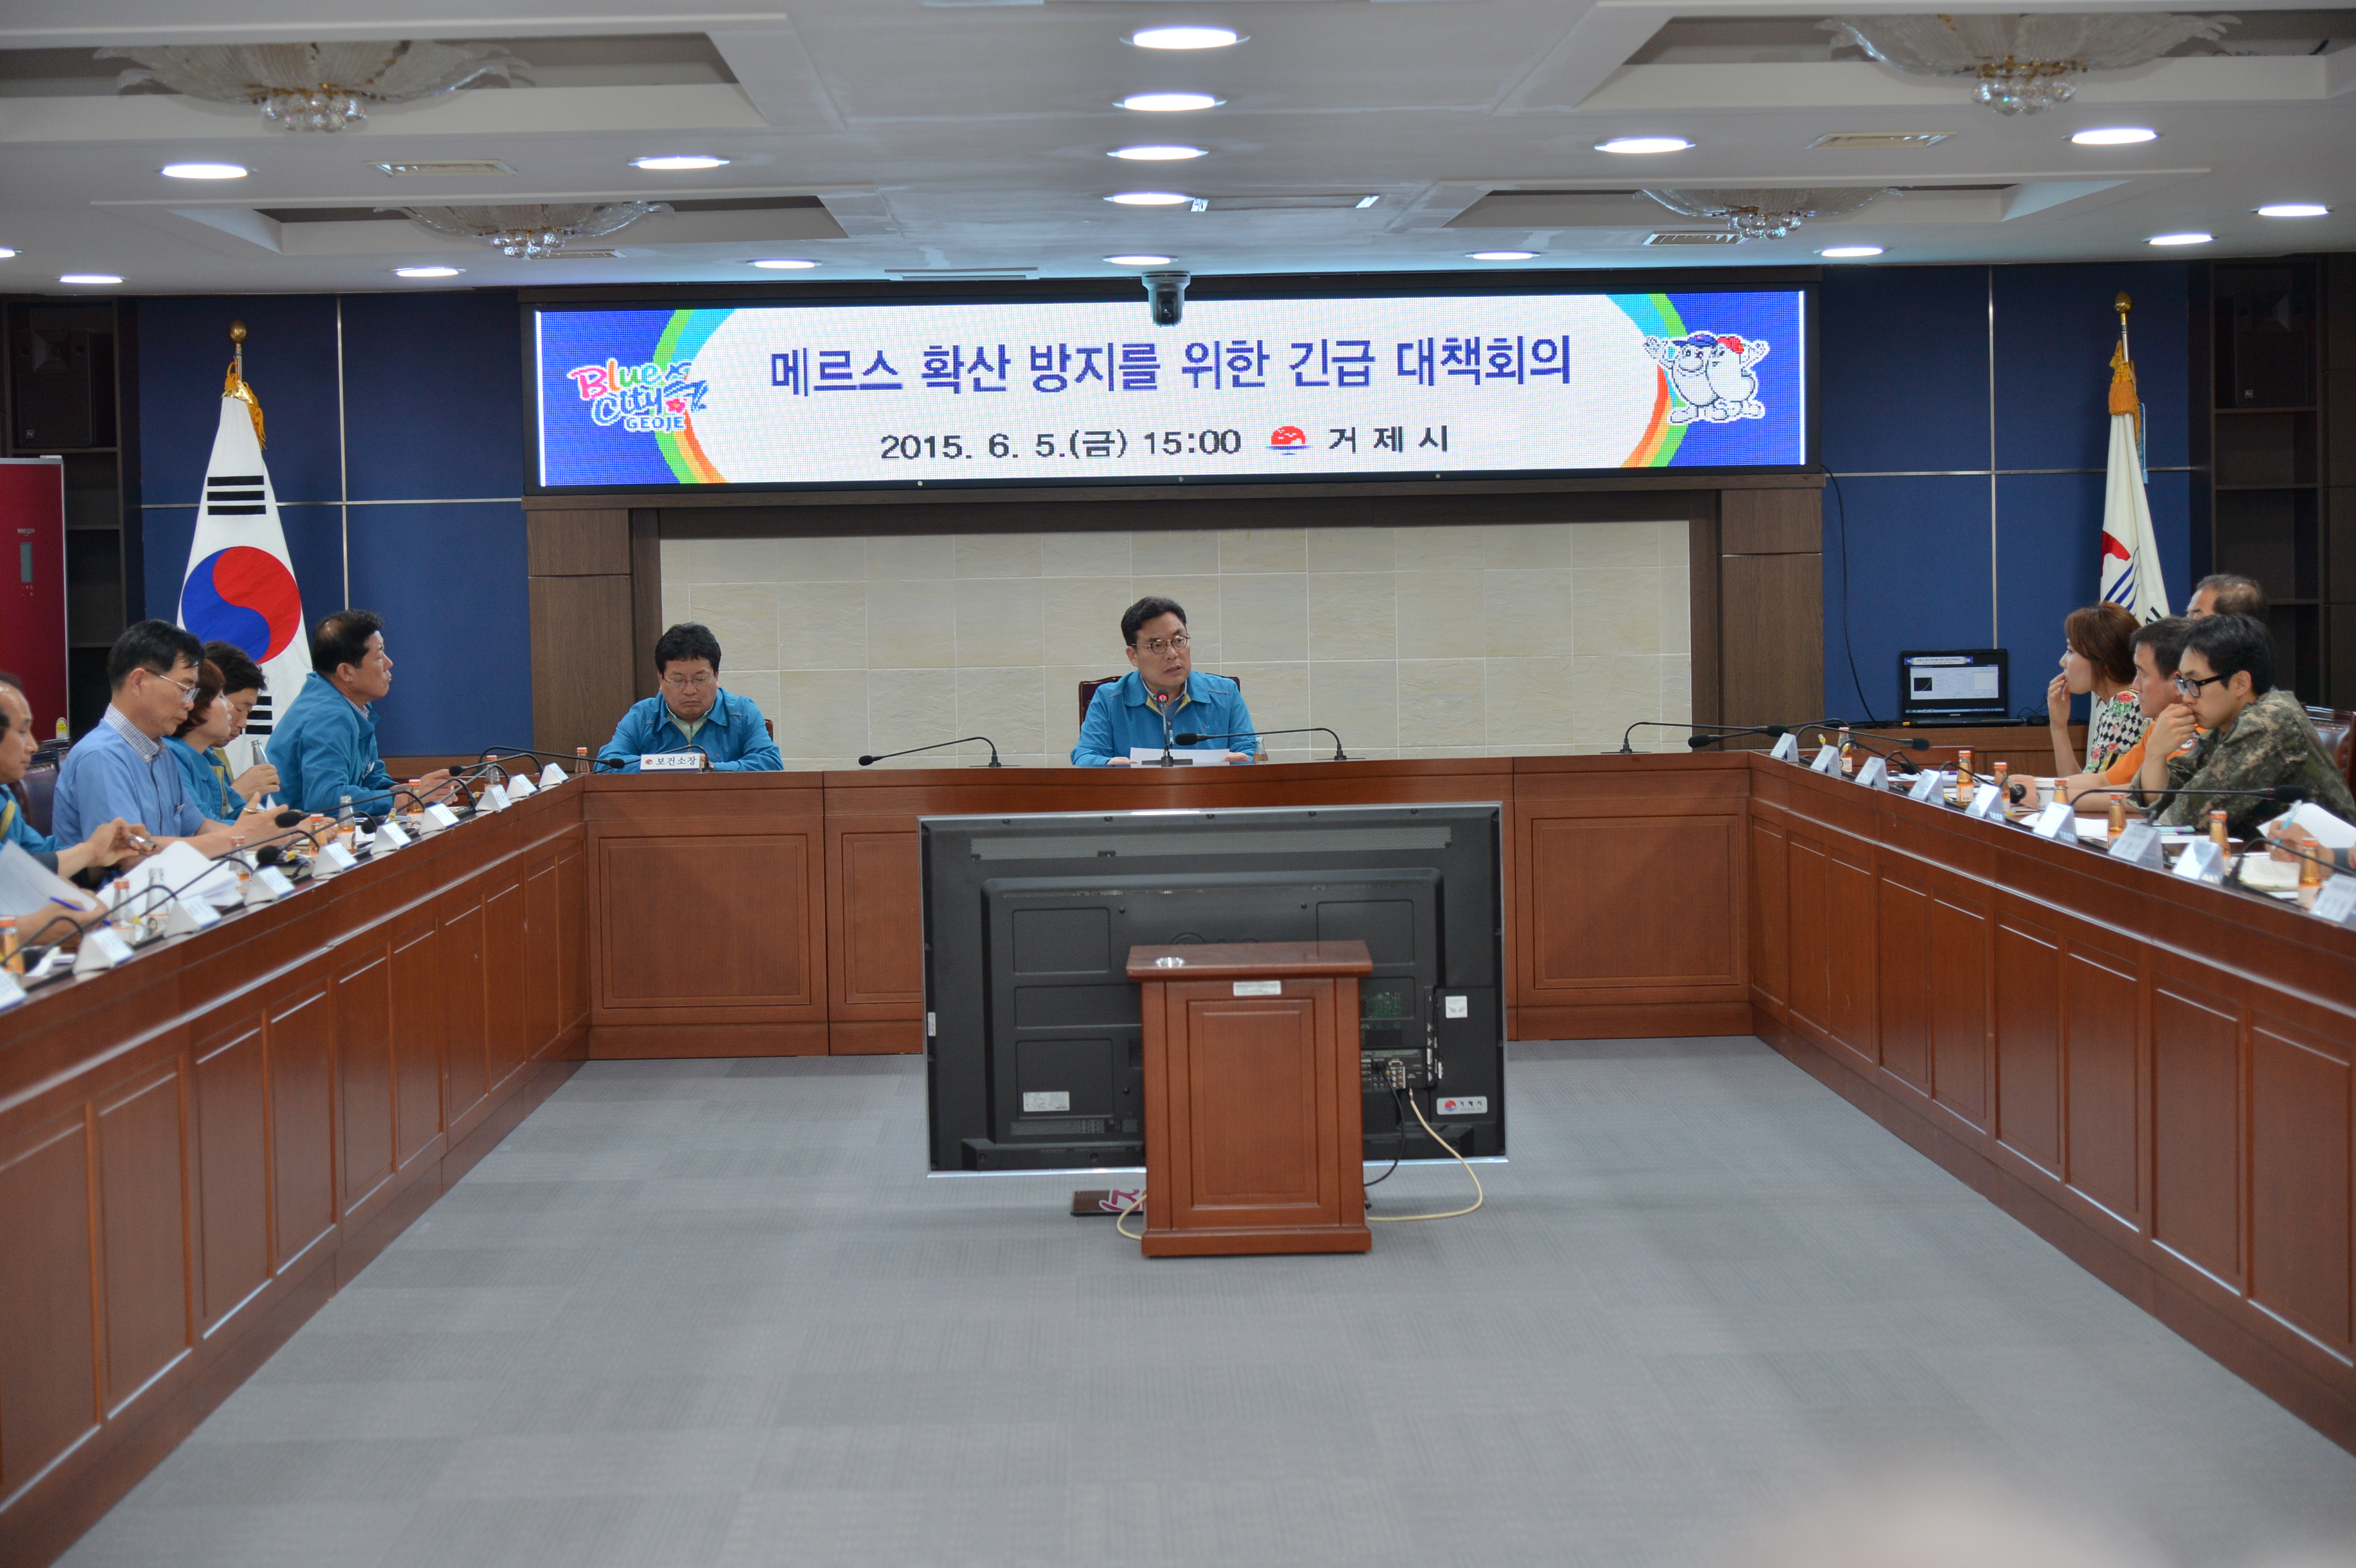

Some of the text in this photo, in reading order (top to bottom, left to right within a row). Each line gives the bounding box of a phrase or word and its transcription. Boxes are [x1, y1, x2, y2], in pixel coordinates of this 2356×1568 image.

[568, 359, 665, 400] Blue
[772, 335, 1570, 396] 메르스 확산 방지를 위한 긴급 대책회의
[592, 382, 663, 425] City
[625, 415, 685, 432] GEOJE
[881, 435, 972, 459] 2015.
[988, 433, 1019, 458] 6.
[1144, 429, 1242, 455] 15:00
[656, 756, 697, 766] 보건소장
